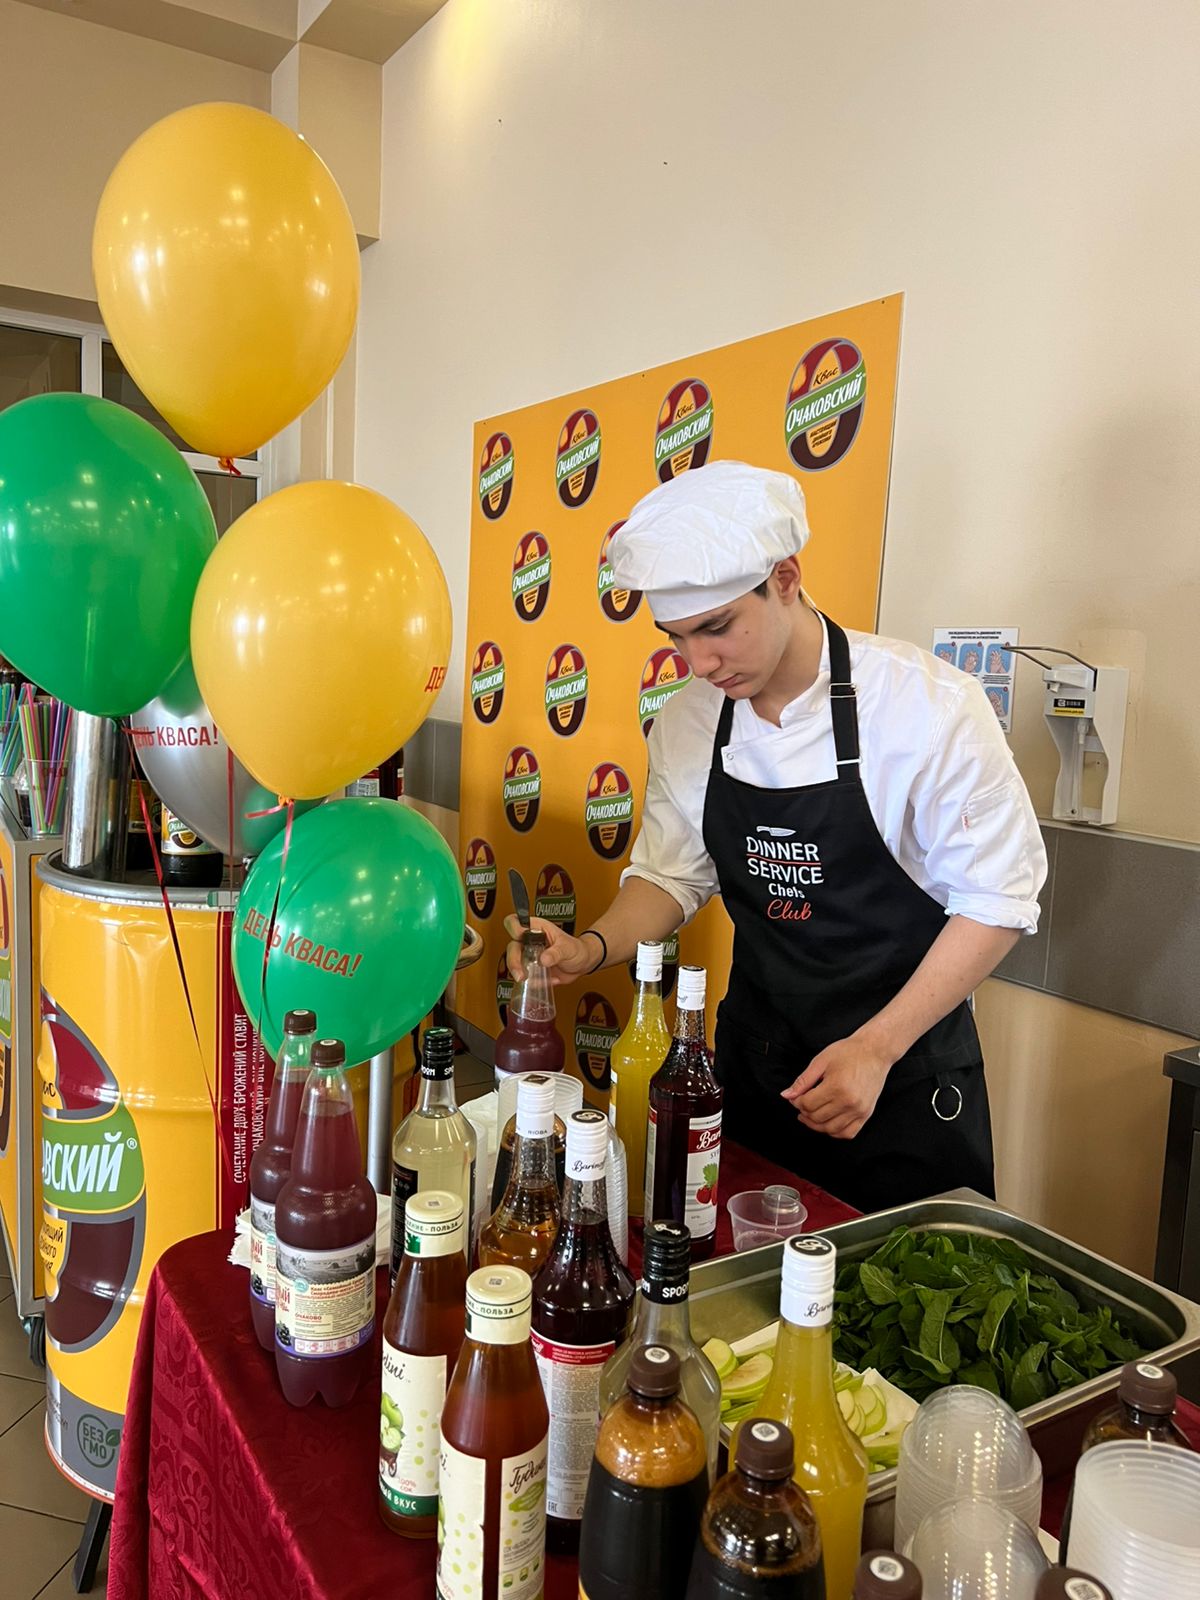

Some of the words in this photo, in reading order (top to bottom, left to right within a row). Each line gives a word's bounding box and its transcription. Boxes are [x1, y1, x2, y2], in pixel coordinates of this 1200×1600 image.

[786, 371, 862, 432] ОЧАКОВСКИЙ
[656, 409, 711, 459] ОЧАКОВСКИЙ
[424, 666, 447, 692] ДЕ
[156, 722, 219, 747] КВАСА!
[504, 776, 540, 799] ОЧАКОВСКИЙ
[586, 797, 632, 821] ОЧАКОВСКИЙ
[746, 836, 820, 861] DINNER
[747, 857, 825, 885] SERVICE
[536, 899, 575, 917] ОЧАКОВСКИЙ
[767, 899, 812, 921] Club
[243, 907, 282, 948] ДЕНЬ
[284, 932, 363, 978] КВАСА!
[233, 1013, 247, 1049] СТАВИТ
[233, 1050, 247, 1104] БРОЖЕНИЙ
[233, 1106, 248, 1129] ДВУХ
[42, 1131, 124, 1193] ВСКИЙ
[430, 1221, 459, 1233] ПОЛЬЗА
[480, 1307, 514, 1316] ПОЛЬЗА
[383, 1353, 405, 1380] dini
[82, 1421, 104, 1444] БЕЗ
[82, 1436, 108, 1460] ГМО
[394, 1495, 417, 1511] ВКУС
